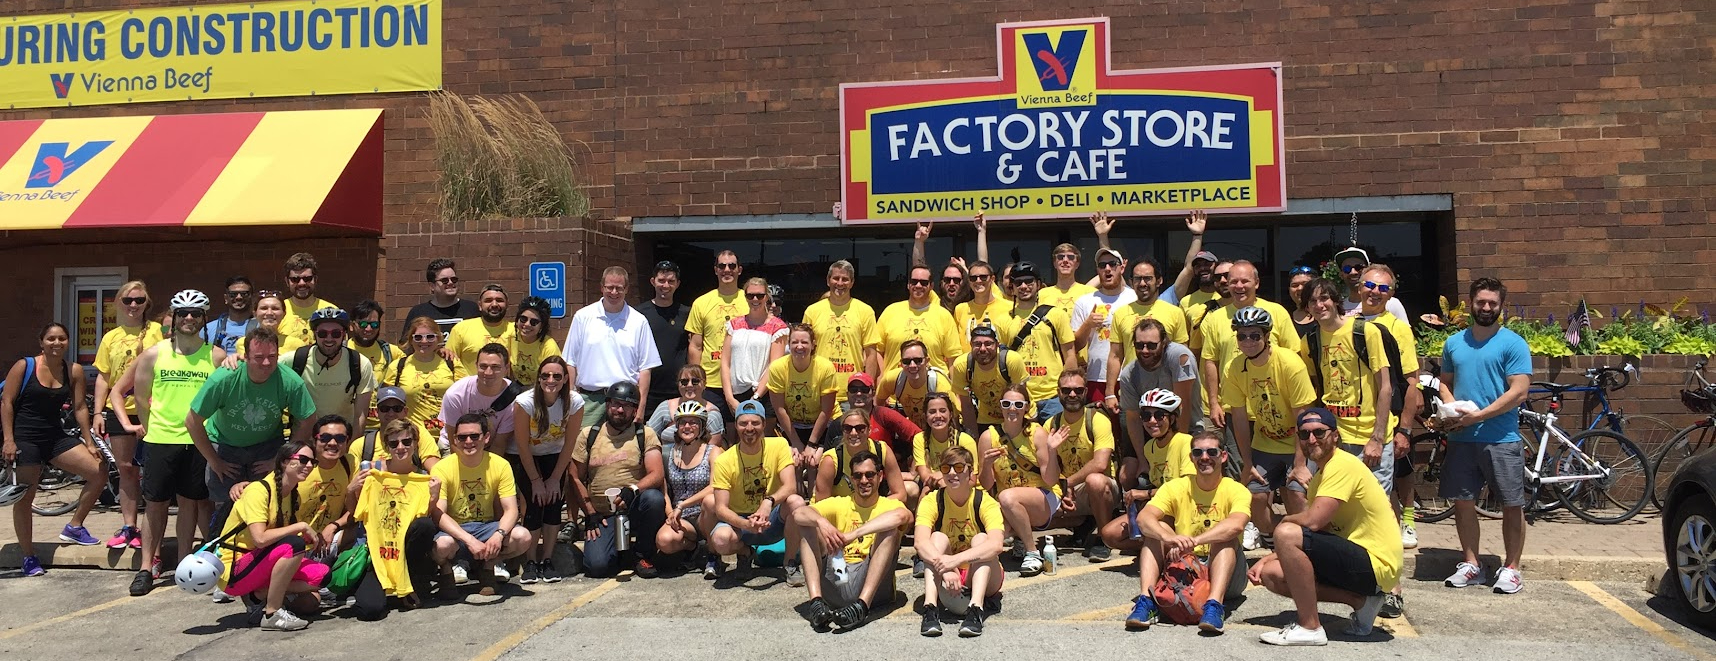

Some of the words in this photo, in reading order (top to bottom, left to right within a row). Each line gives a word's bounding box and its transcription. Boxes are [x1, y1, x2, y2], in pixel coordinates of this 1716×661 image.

[120, 4, 429, 60] CONSTRUCTION
[80, 73, 157, 93] Vienna
[164, 66, 213, 93] Beef
[1021, 95, 1061, 104] Vienna
[1066, 91, 1095, 104] Beef
[888, 111, 1090, 161] FACTORY
[1101, 109, 1236, 150] STORE
[996, 153, 1023, 184] &
[1036, 148, 1127, 182] CAFE
[40, 189, 79, 202] Beef
[876, 197, 975, 214] SANDWICH
[981, 194, 1030, 210] SHOP
[1050, 193, 1090, 207] DELI
[1111, 186, 1251, 205] MARKETPLACE
[83, 316, 117, 324] CRAM
[160, 369, 209, 380] Breakaway
